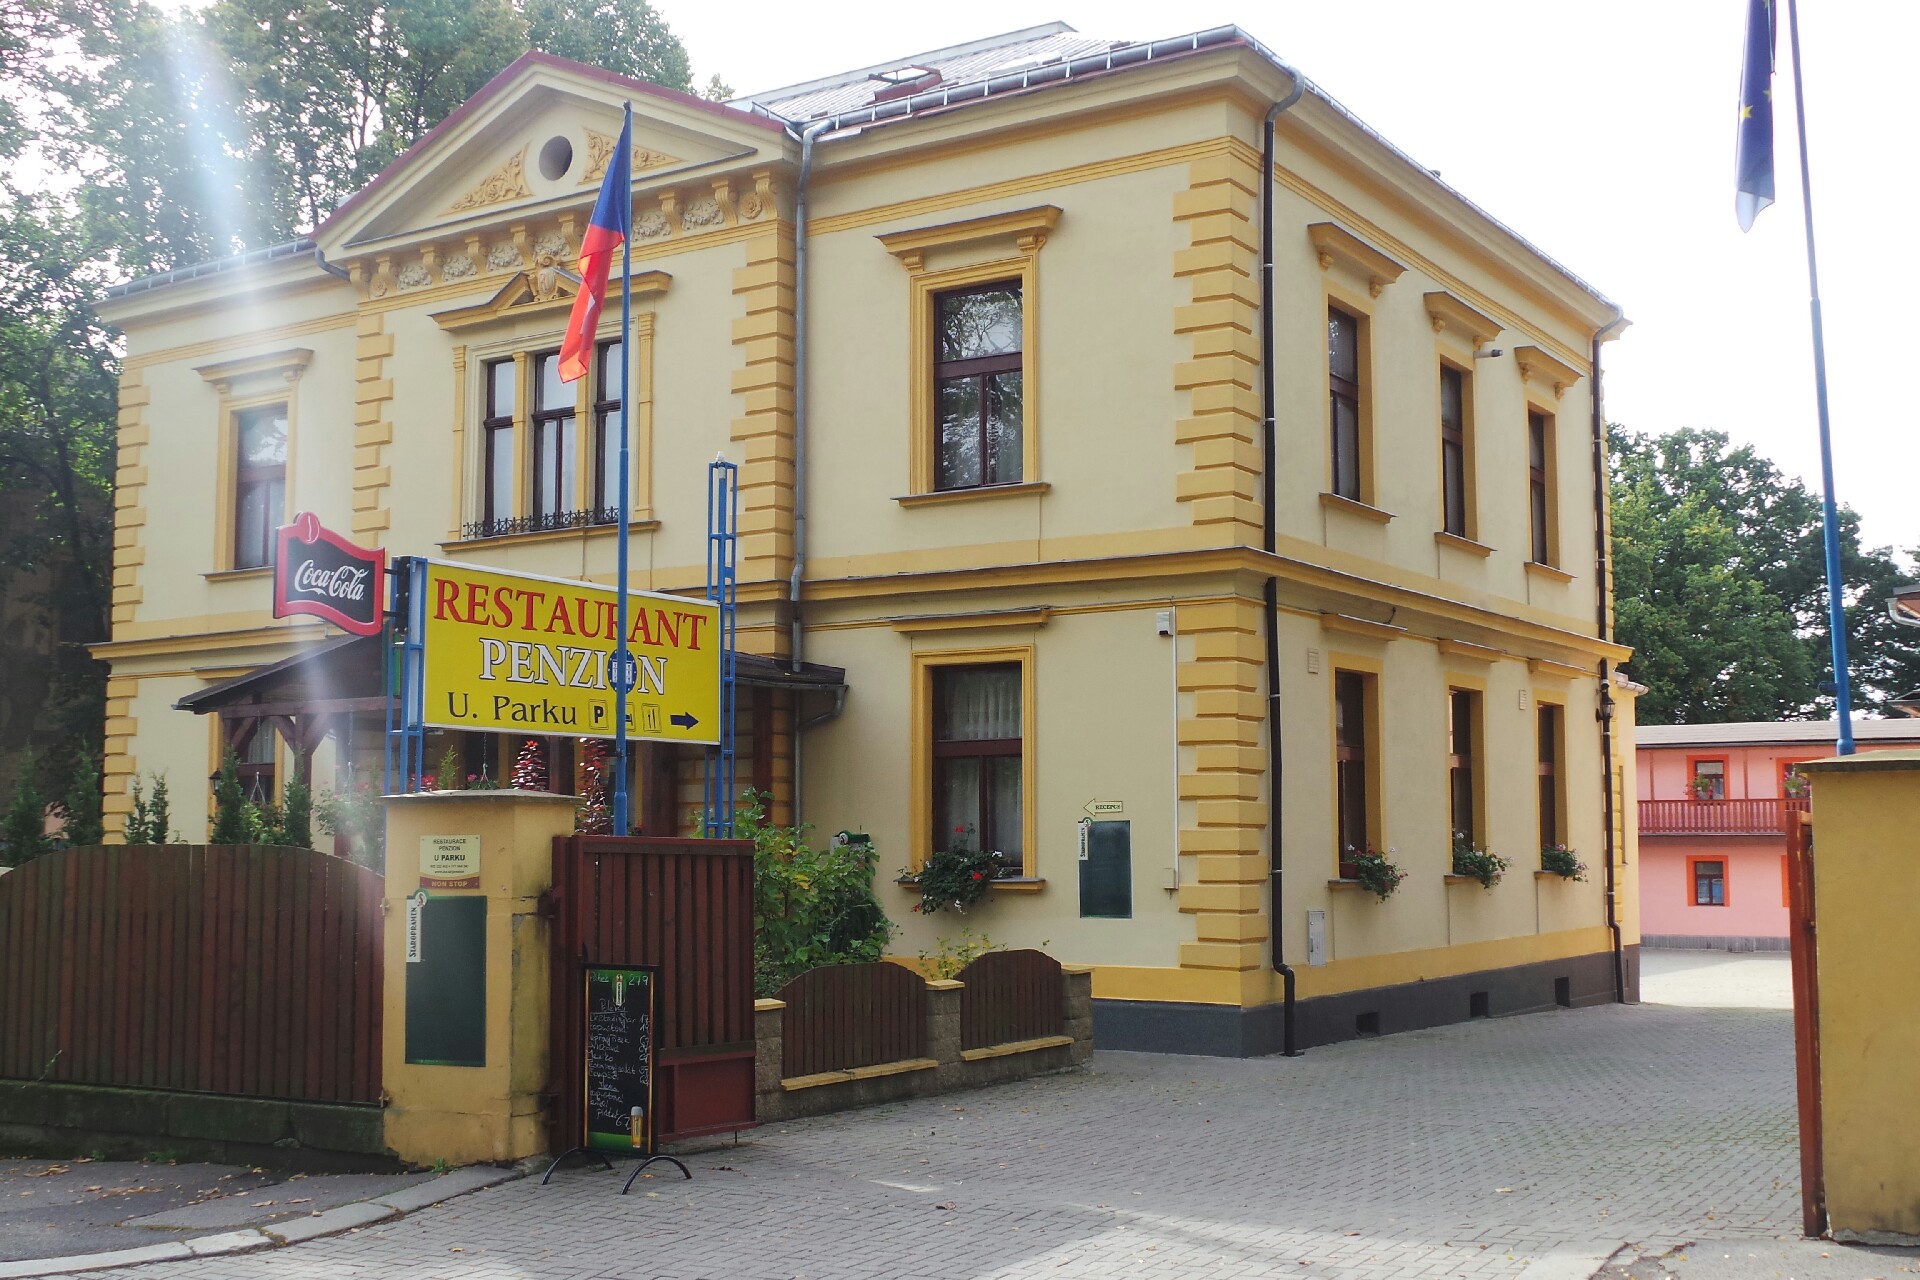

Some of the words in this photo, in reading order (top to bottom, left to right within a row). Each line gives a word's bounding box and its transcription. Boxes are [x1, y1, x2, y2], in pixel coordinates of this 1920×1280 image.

[294, 559, 369, 600] Coca-Cola
[447, 691, 479, 719] U.
[492, 695, 577, 725] Parku
